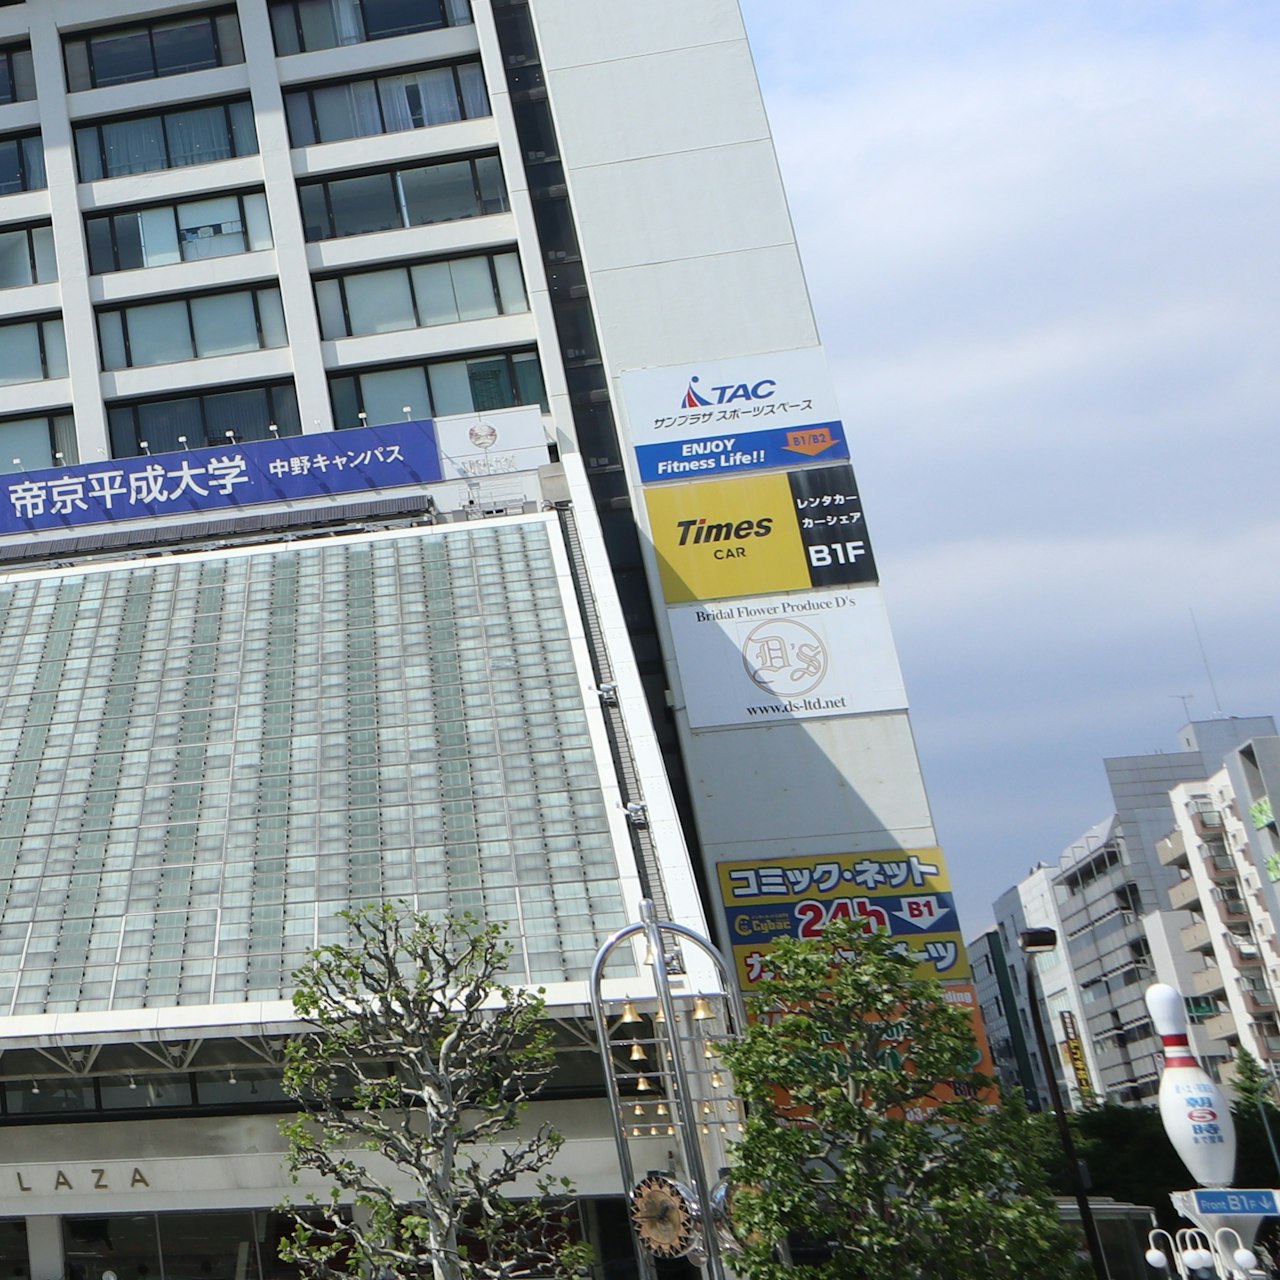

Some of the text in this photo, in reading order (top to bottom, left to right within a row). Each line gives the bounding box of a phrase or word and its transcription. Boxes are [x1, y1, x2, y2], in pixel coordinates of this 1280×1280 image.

[711, 379, 777, 405] TAC
[654, 399, 813, 430] サンプラザ スポーツスペース
[682, 438, 736, 457] ENJOY
[793, 433, 827, 447] B1/B2
[269, 444, 405, 479] 中野キャンパス
[658, 450, 766, 475] Fitness Life!!
[8, 455, 249, 519] 帝京平成大学
[796, 493, 858, 510] レンタカー
[677, 518, 773, 546] Times
[802, 511, 862, 529] カーシェア
[714, 547, 746, 560] CAR
[808, 540, 866, 567] B1F
[695, 596, 857, 623] Bridal Flower Produce D's
[746, 696, 848, 716] www.ds-ltd.net
[729, 856, 939, 897] コミック・ネット
[907, 900, 935, 918] B1
[752, 919, 792, 934] Cybac
